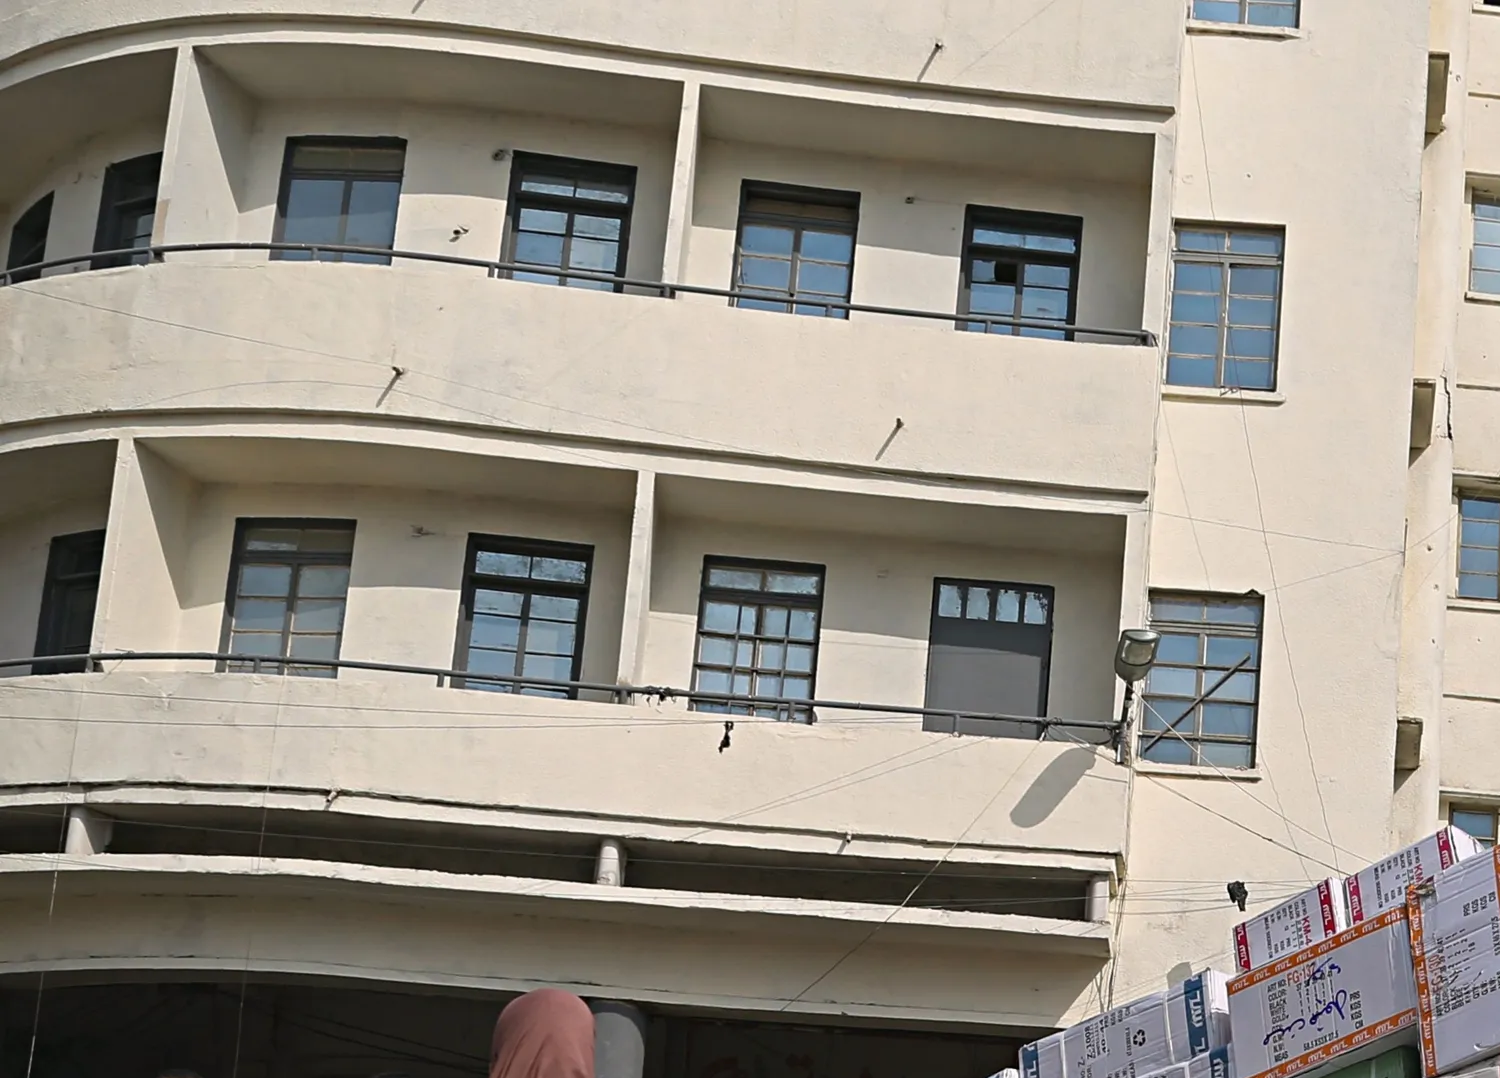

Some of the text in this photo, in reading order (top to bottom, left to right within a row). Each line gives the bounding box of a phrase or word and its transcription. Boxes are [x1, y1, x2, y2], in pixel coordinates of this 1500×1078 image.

[1350, 991, 1361, 1001] PRS
[1269, 999, 1287, 1010] BLACK
[1350, 1001, 1362, 1010] KGS
[1350, 1010, 1363, 1021] KGS
